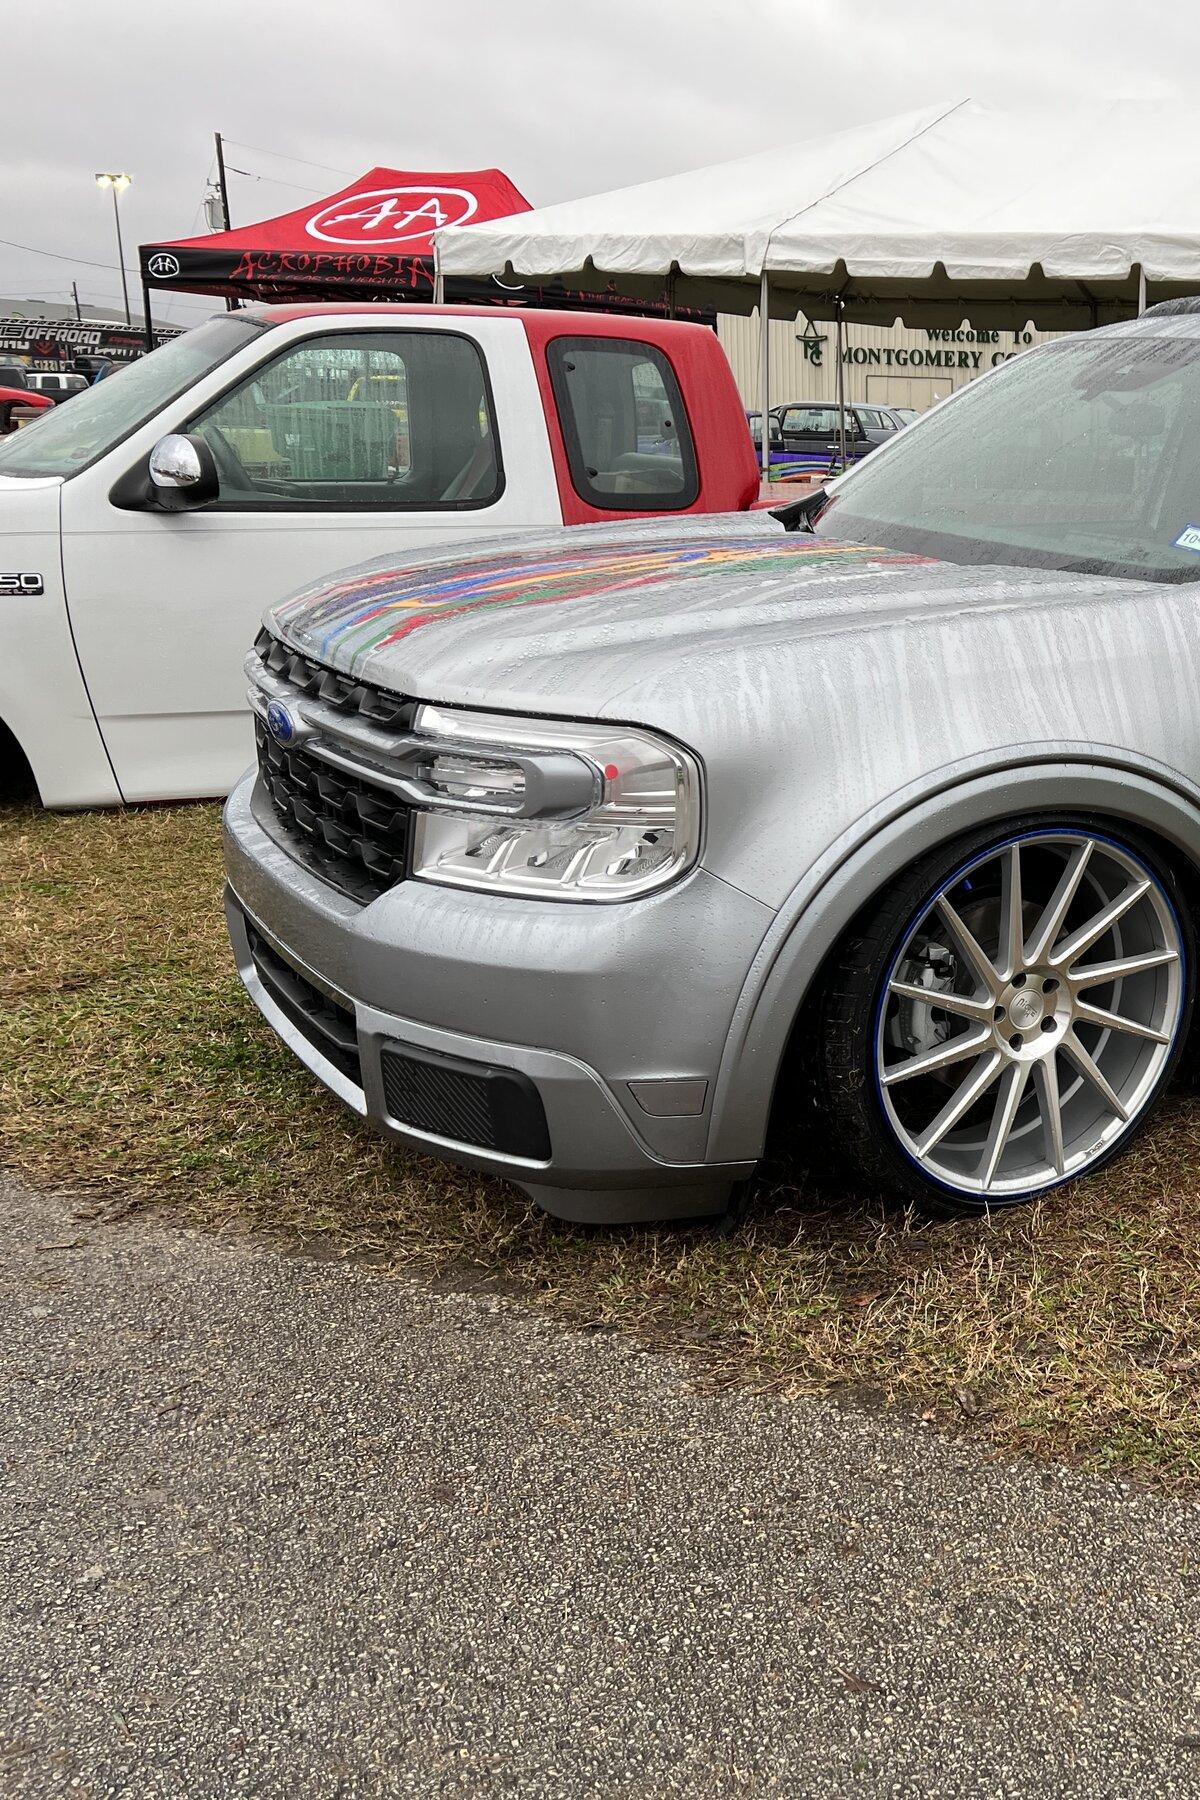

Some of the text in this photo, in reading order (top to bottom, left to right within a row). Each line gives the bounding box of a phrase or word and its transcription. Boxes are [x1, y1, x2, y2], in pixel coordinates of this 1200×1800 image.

[229, 252, 434, 288] ACROPHOBIA
[285, 274, 322, 282] FEAR
[349, 277, 407, 285] HEIGHTS
[24, 326, 102, 345] OFFROAD
[836, 346, 982, 369] MONTGOMERY
